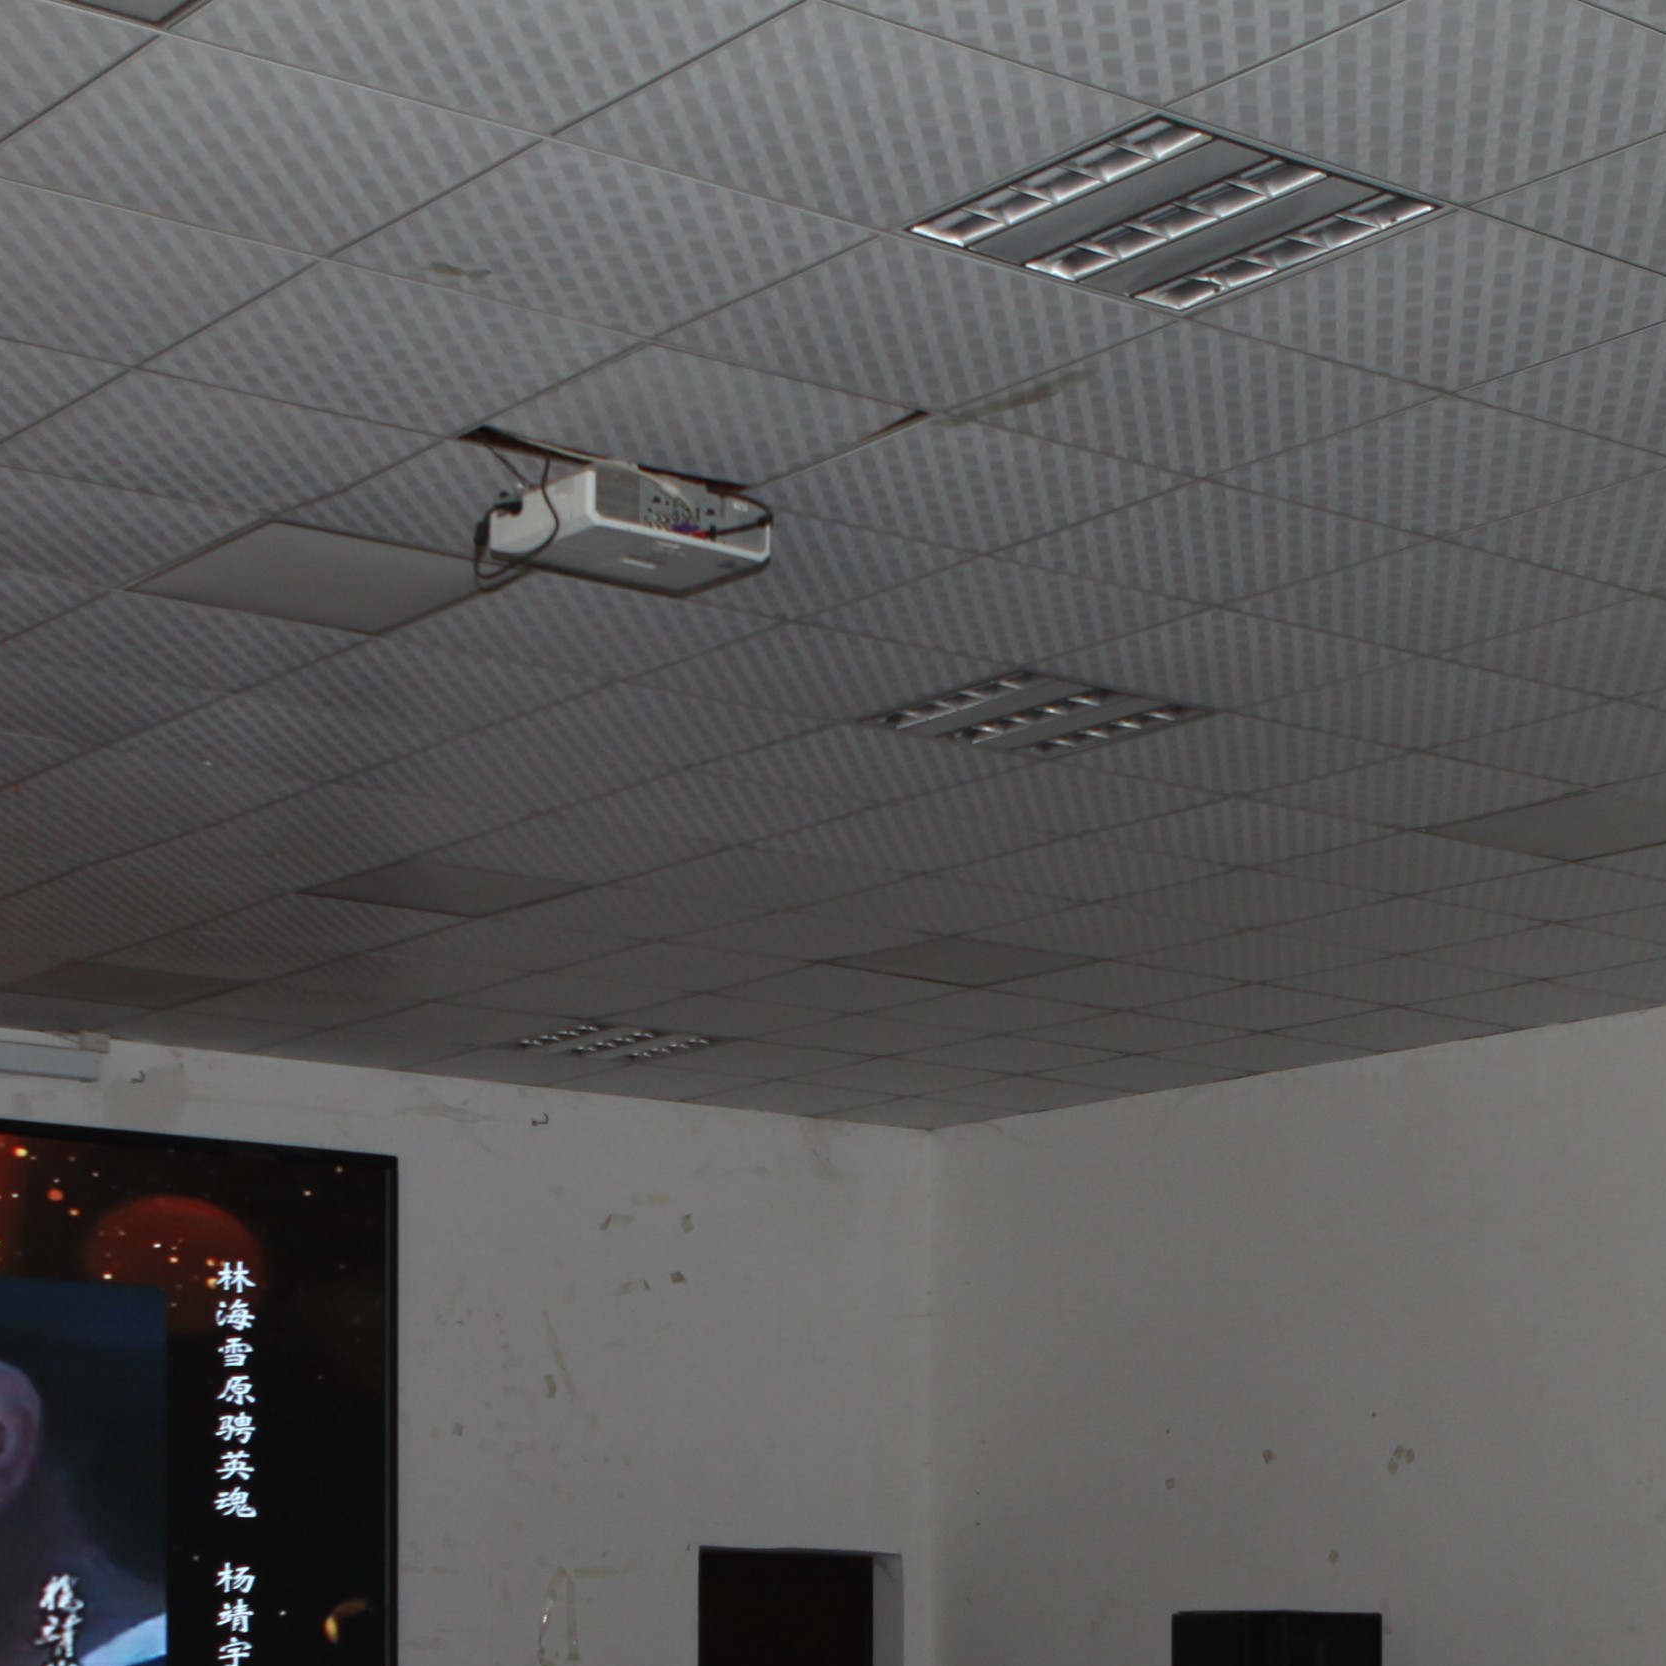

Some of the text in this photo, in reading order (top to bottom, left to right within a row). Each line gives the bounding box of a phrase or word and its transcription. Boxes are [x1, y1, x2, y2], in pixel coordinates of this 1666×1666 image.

[214, 1261, 257, 1518] 林海雪原骋英魂
